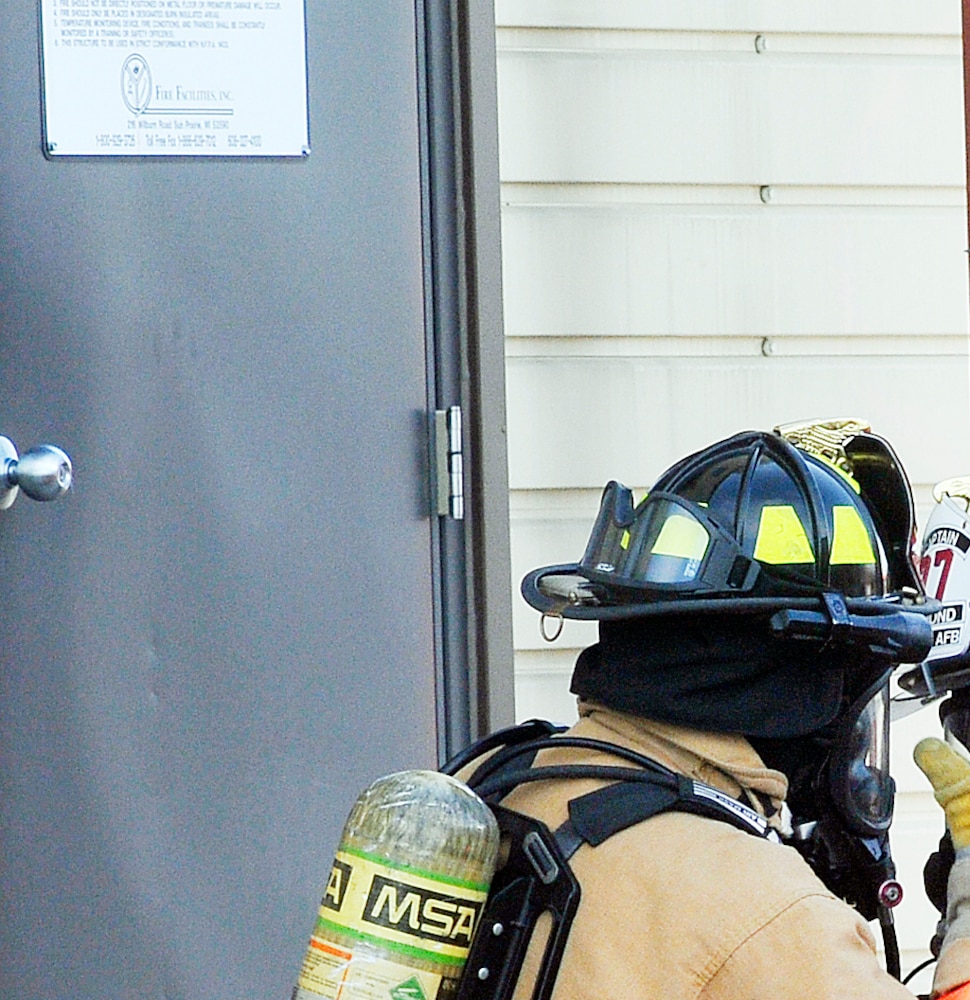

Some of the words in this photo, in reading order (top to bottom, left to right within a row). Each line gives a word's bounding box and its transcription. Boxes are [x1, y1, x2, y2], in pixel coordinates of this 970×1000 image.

[928, 528, 960, 547] PTAIN
[927, 607, 957, 625] UND
[934, 629, 960, 646] AFB
[370, 884, 476, 942] MSA
